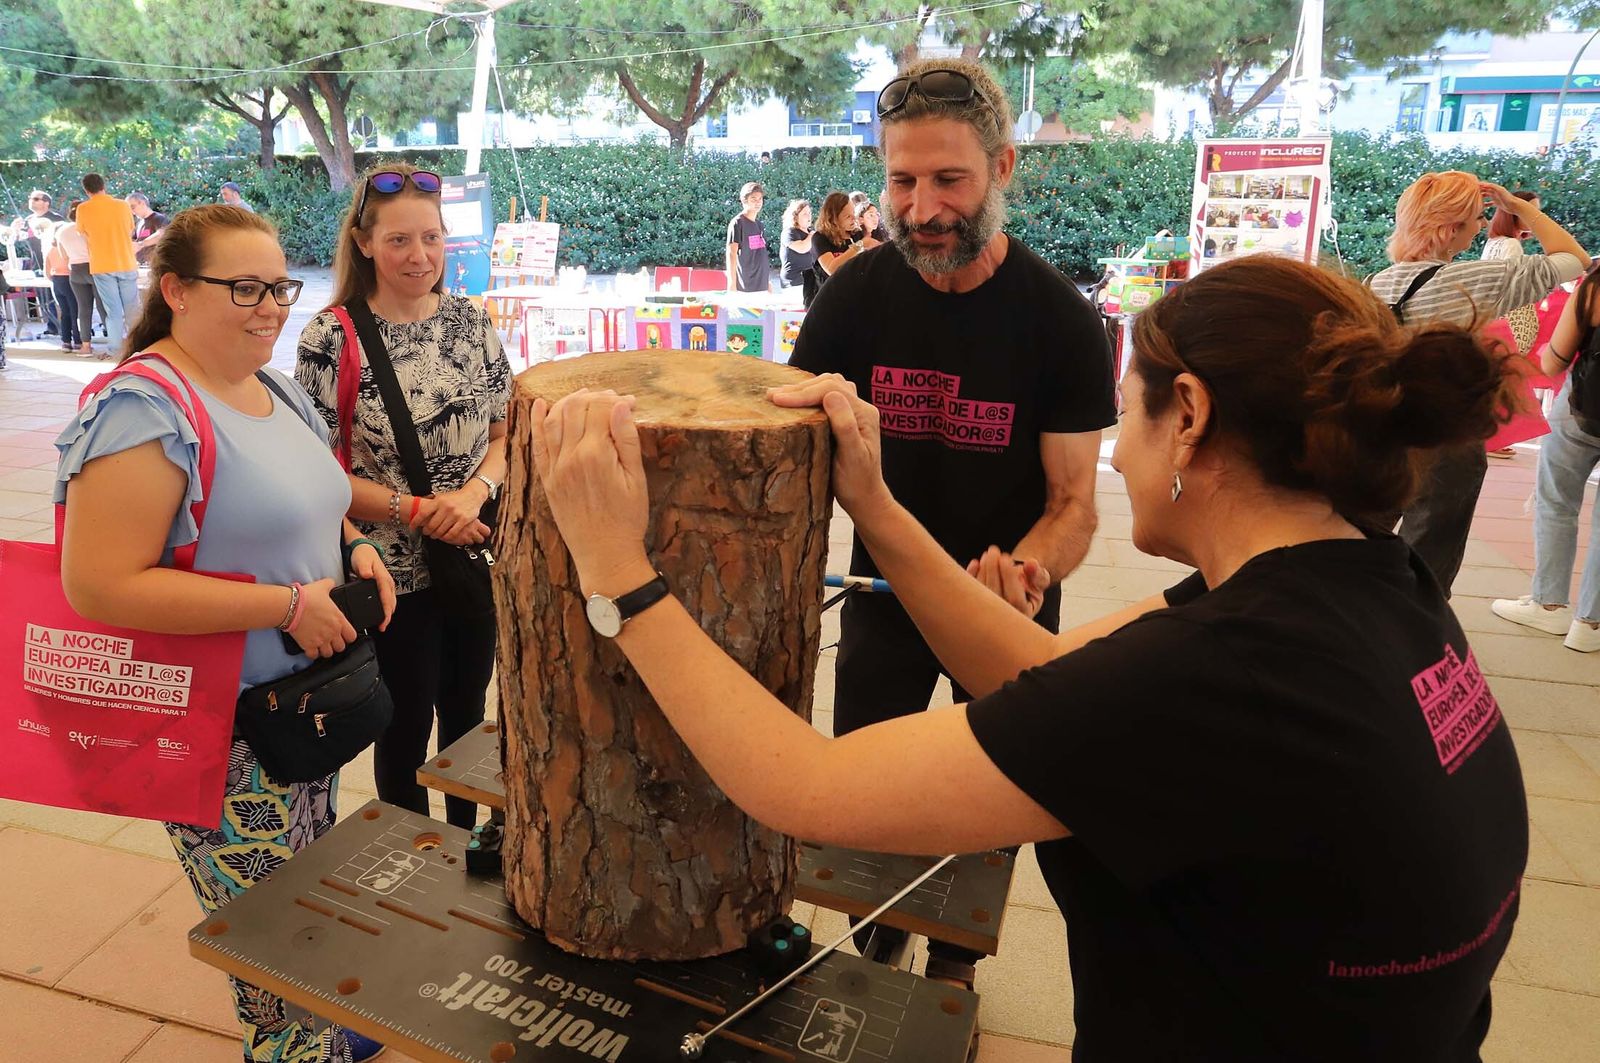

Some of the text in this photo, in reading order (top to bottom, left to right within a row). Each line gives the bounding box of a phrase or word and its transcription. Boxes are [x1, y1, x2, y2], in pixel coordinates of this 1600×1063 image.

[875, 370, 956, 394] LA NOCHE
[874, 390, 1010, 421] EUROPEA DE L@S
[880, 411, 1007, 442] NVESTIGADOR@S
[29, 628, 129, 656] LA NOCHE
[28, 648, 187, 684] EUROPEA DE L@S
[27, 667, 184, 704] INVESTIGADOR@S
[1415, 677, 1434, 701] LA
[58, 694, 91, 706] HOMBRES
[92, 700, 107, 708] QUE
[108, 702, 133, 710] HACEN
[133, 705, 160, 714] CIENCIA
[161, 708, 179, 716] PARA
[483, 954, 633, 1018] master 700
